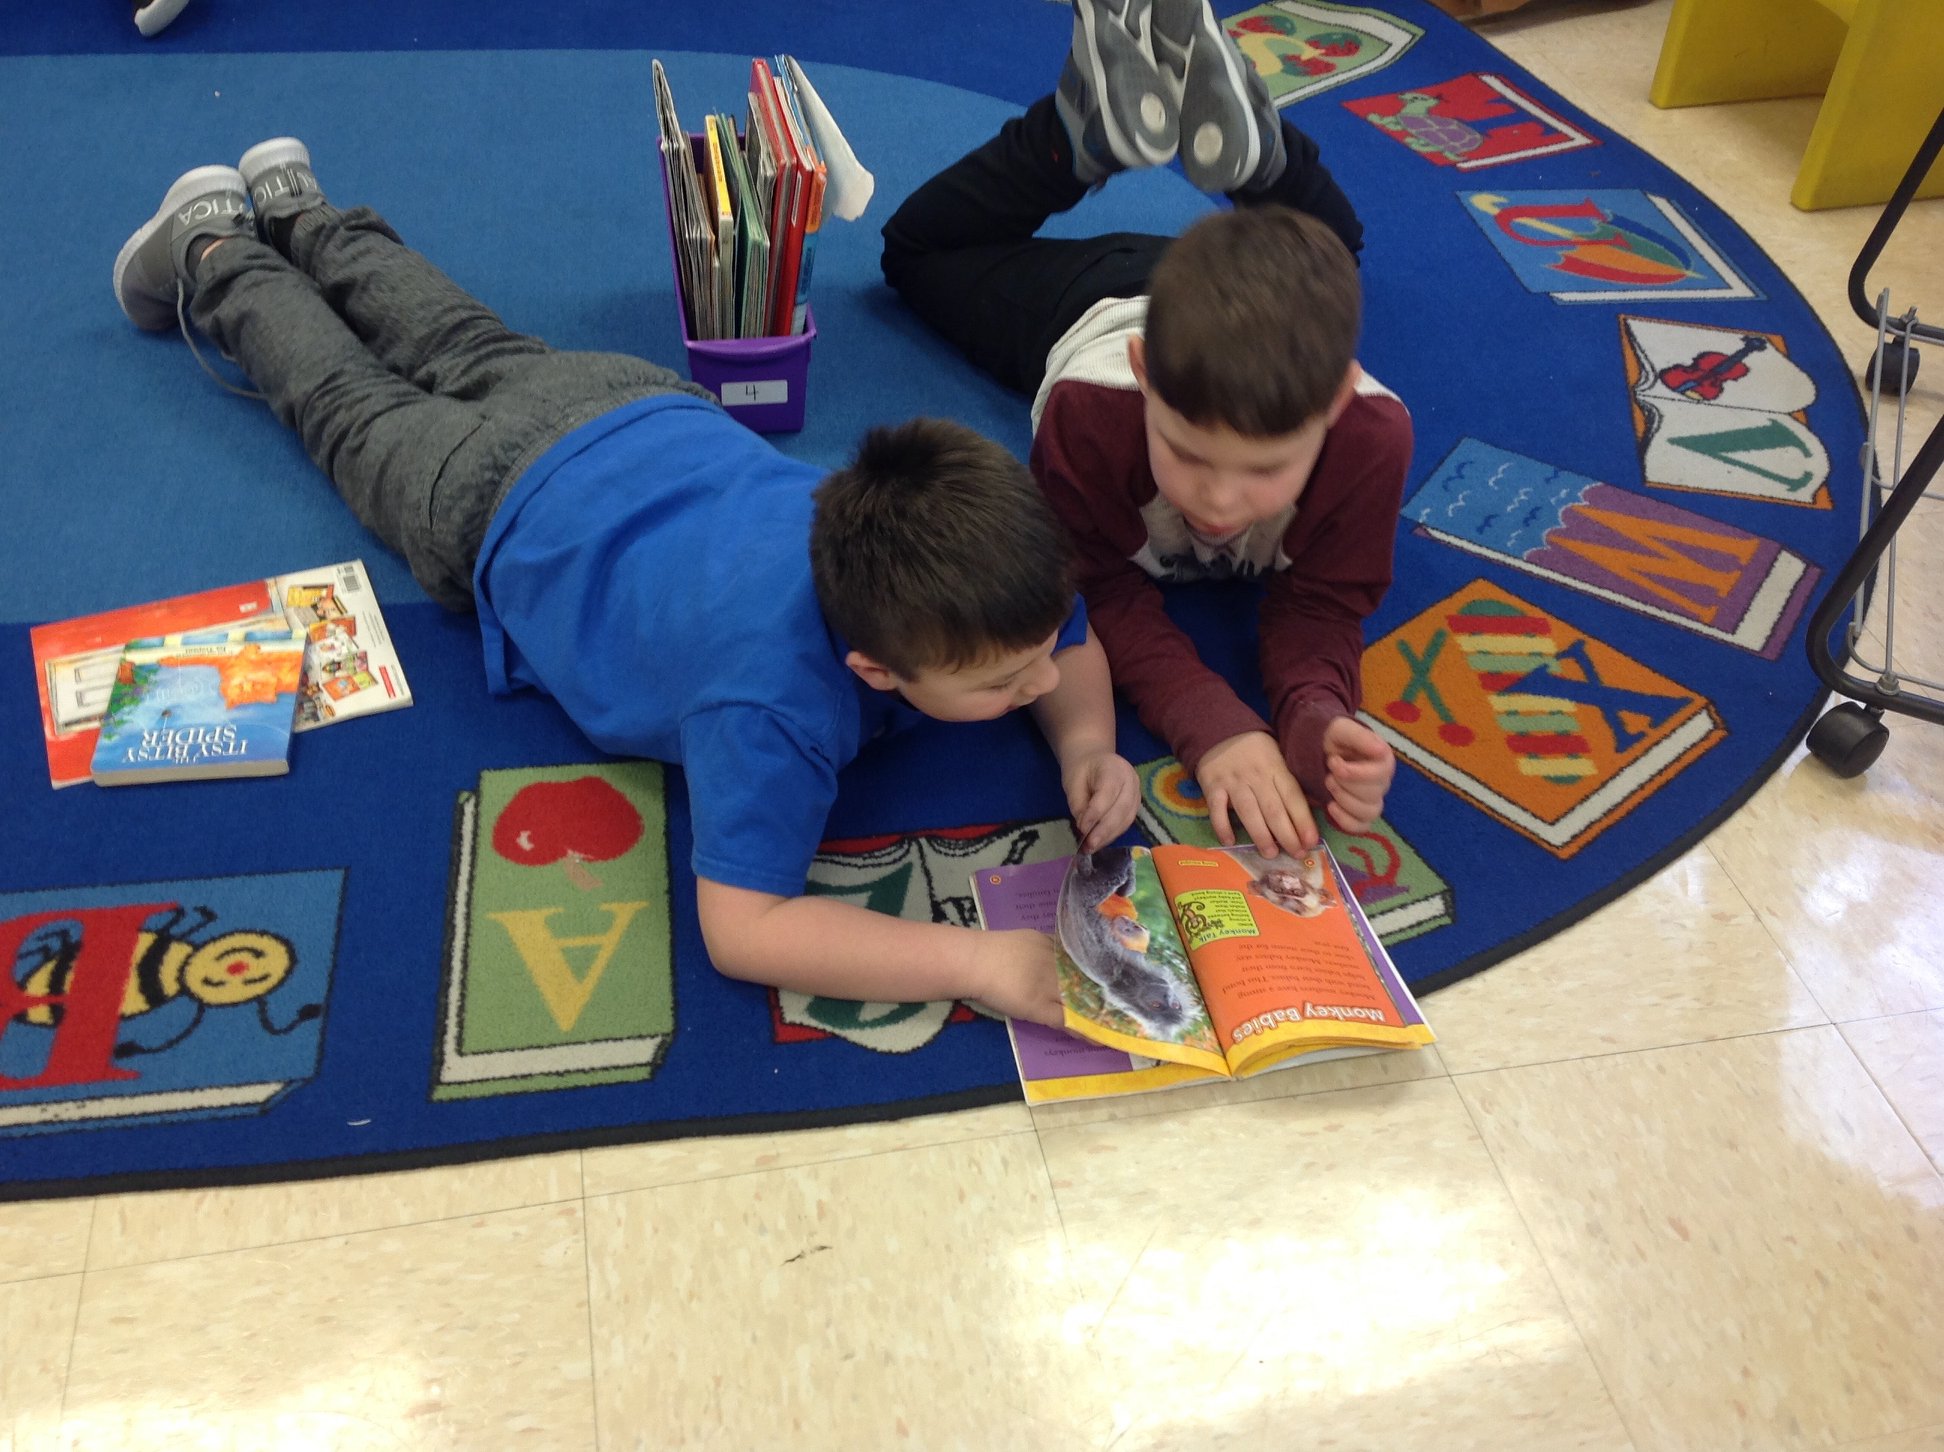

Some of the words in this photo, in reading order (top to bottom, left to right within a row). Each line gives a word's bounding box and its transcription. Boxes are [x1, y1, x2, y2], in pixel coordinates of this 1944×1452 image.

[745, 384, 760, 401] 4
[1667, 418, 1814, 492] V
[1549, 504, 1766, 624] W
[1498, 639, 1691, 756] X
[140, 724, 237, 748] SPIDER
[121, 744, 189, 764] BITSY
[198, 739, 248, 759] ITSY
[1199, 932, 1216, 943] Talk
[1219, 928, 1256, 937] Monkey
[486, 900, 650, 1032] A
[1303, 1001, 1385, 1023] Monkey
[1231, 1007, 1302, 1044] Babies
